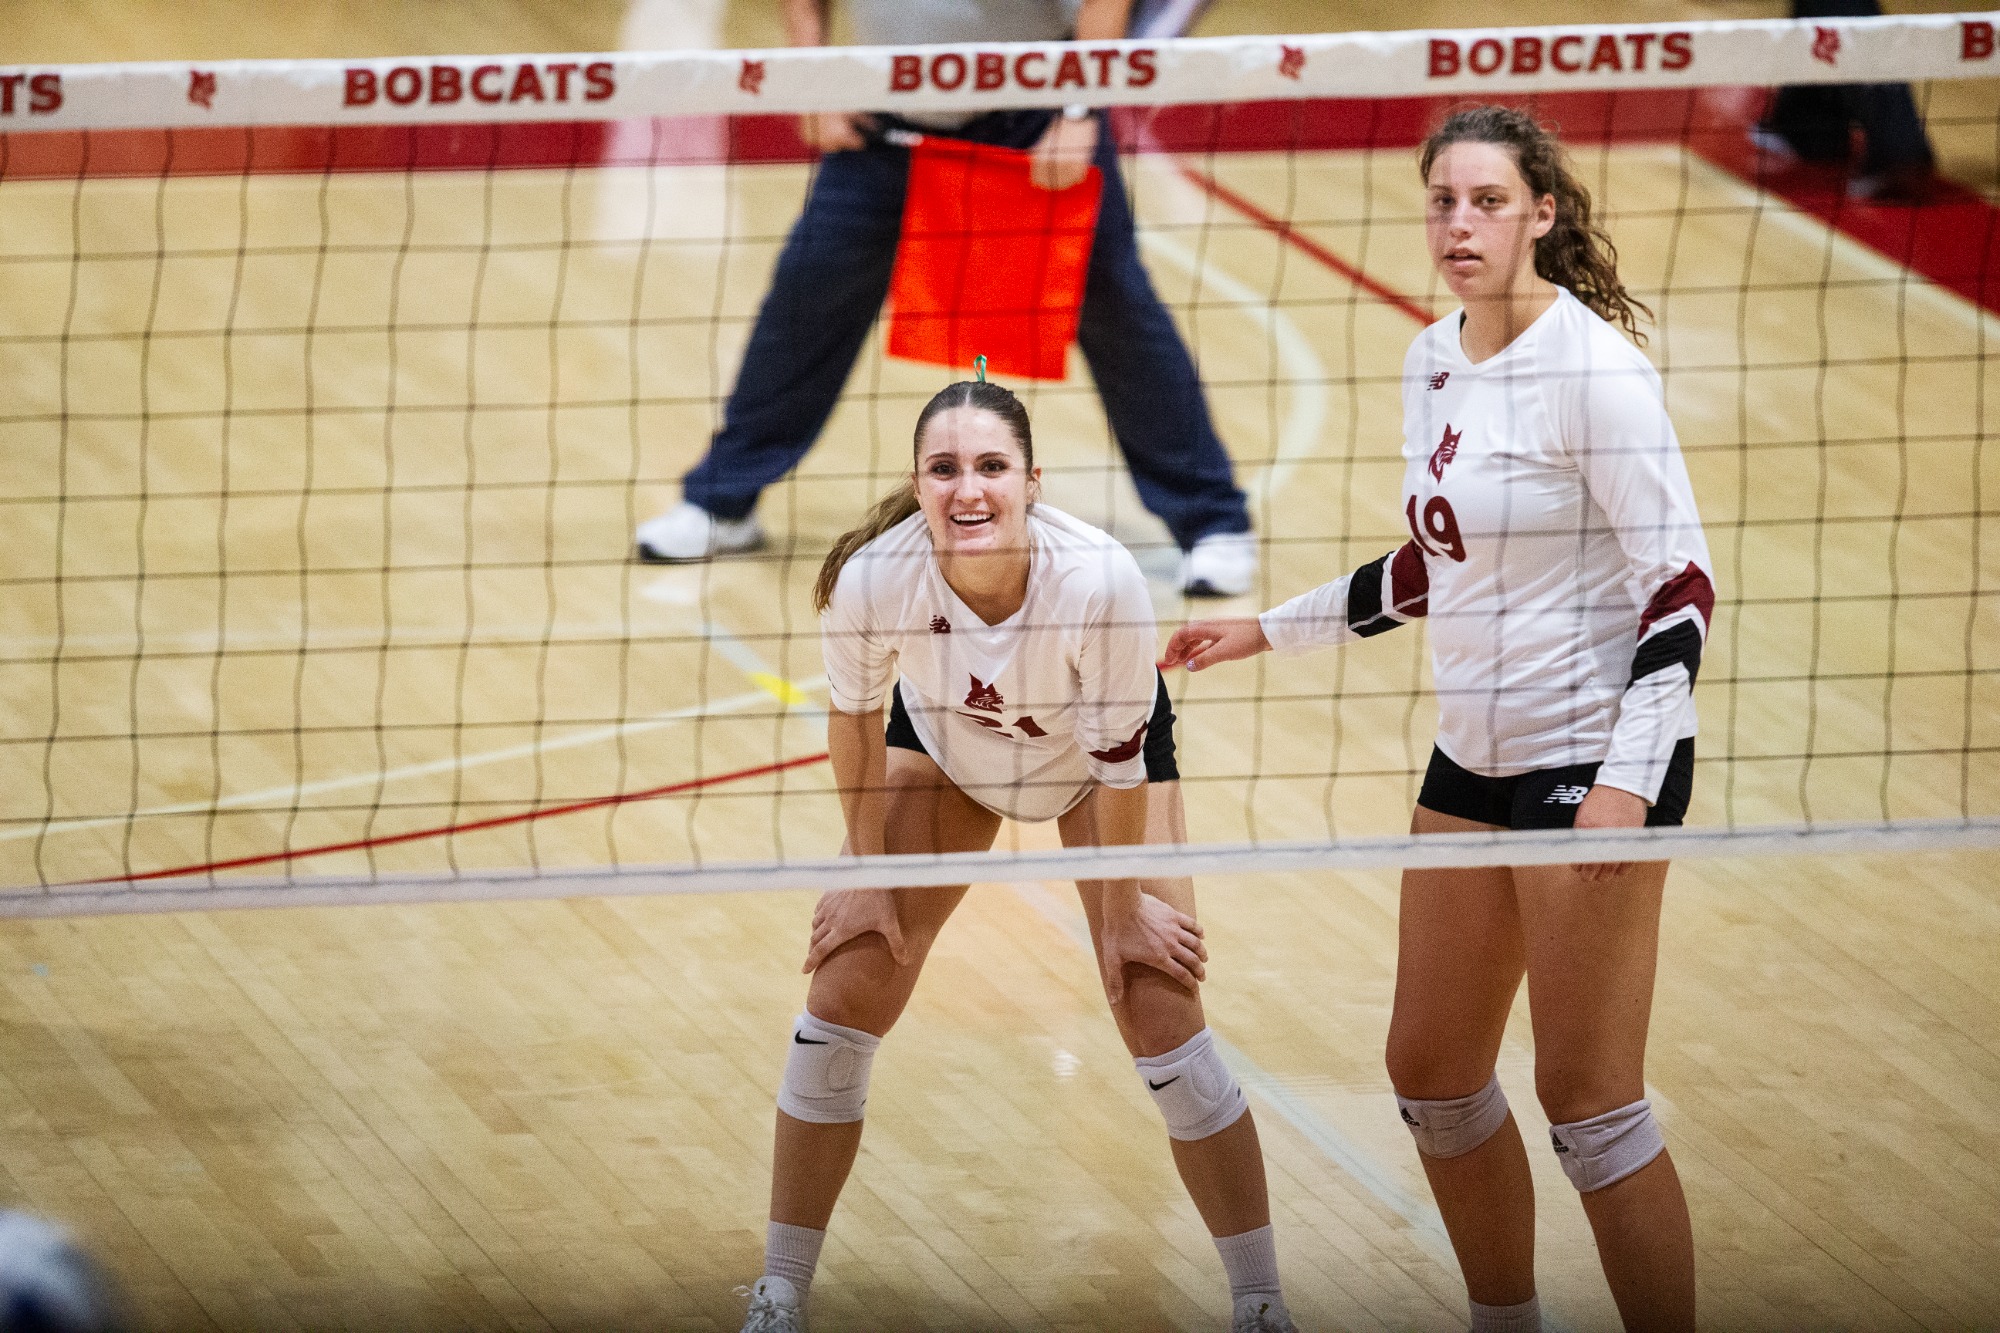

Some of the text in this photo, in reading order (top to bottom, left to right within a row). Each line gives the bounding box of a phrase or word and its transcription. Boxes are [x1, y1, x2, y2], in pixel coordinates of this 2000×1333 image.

[890, 49, 1156, 92] BOBCATS
[1428, 32, 1693, 78] BOBCATS
[343, 62, 615, 107] BOBCATS
[1406, 494, 1466, 563] 19
